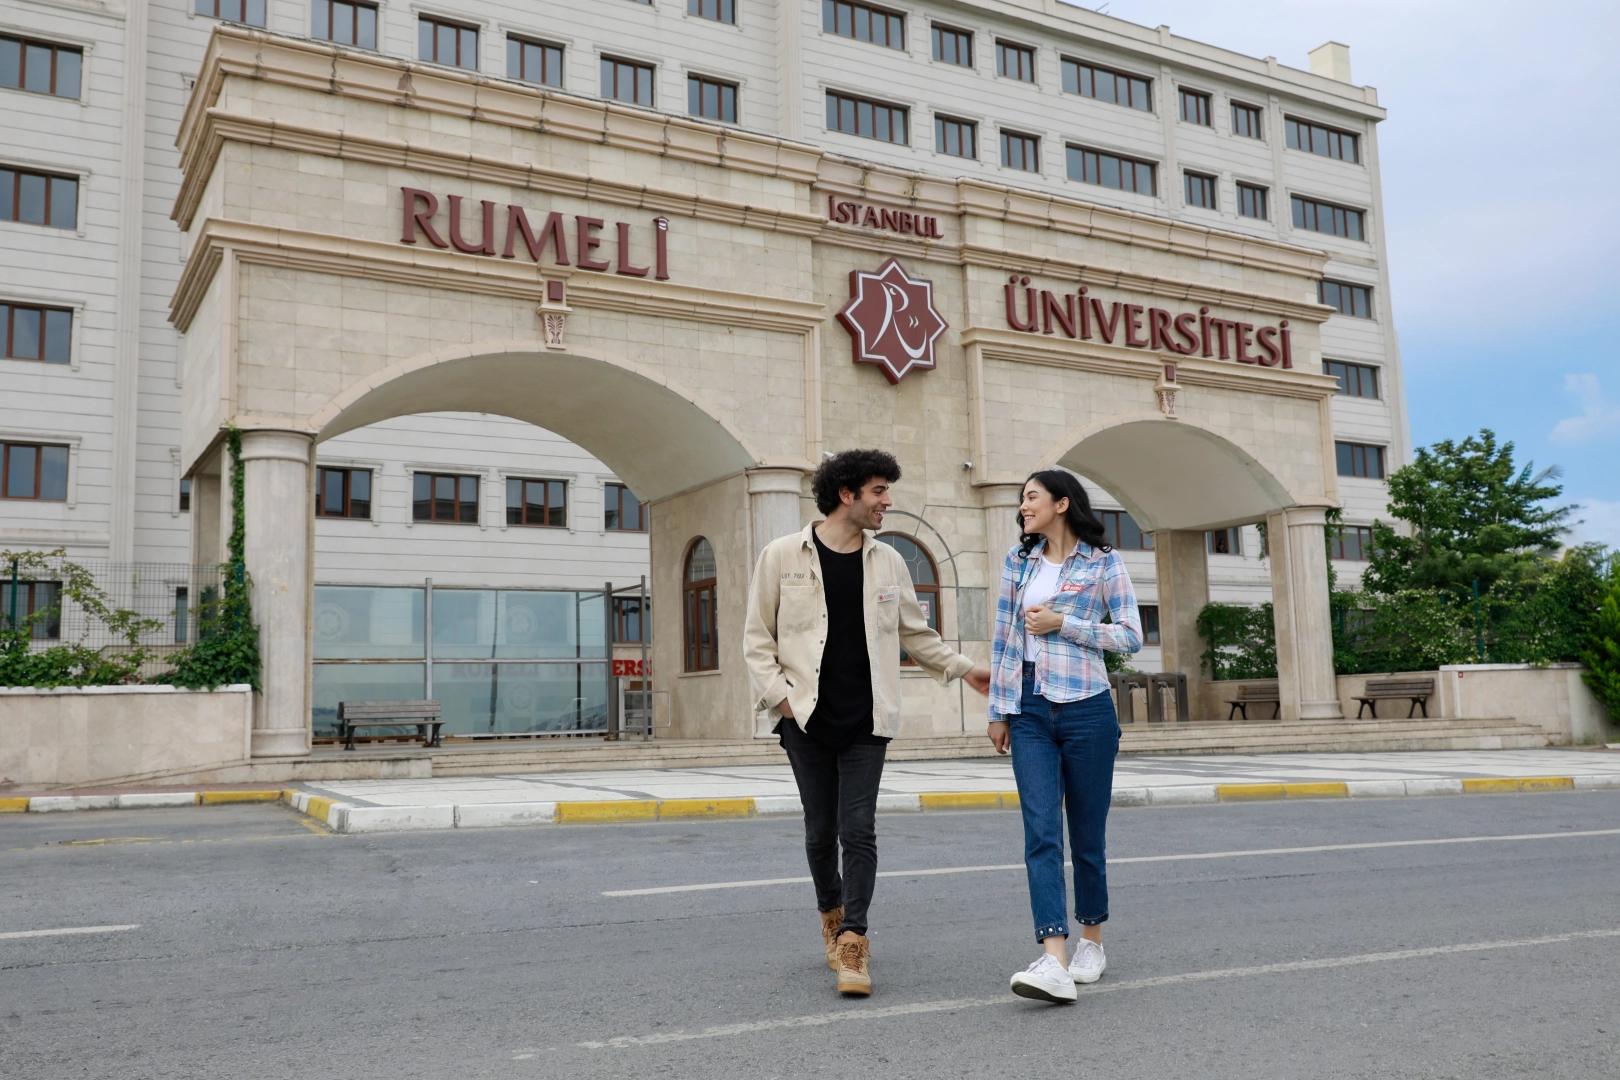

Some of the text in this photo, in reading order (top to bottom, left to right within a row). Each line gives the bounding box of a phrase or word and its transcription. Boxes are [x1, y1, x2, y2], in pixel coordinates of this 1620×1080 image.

[400, 186, 670, 280] RUMELİ
[828, 194, 944, 239] İSTANBUL
[1003, 274, 1293, 369] ÜNİVERSİTESİ
